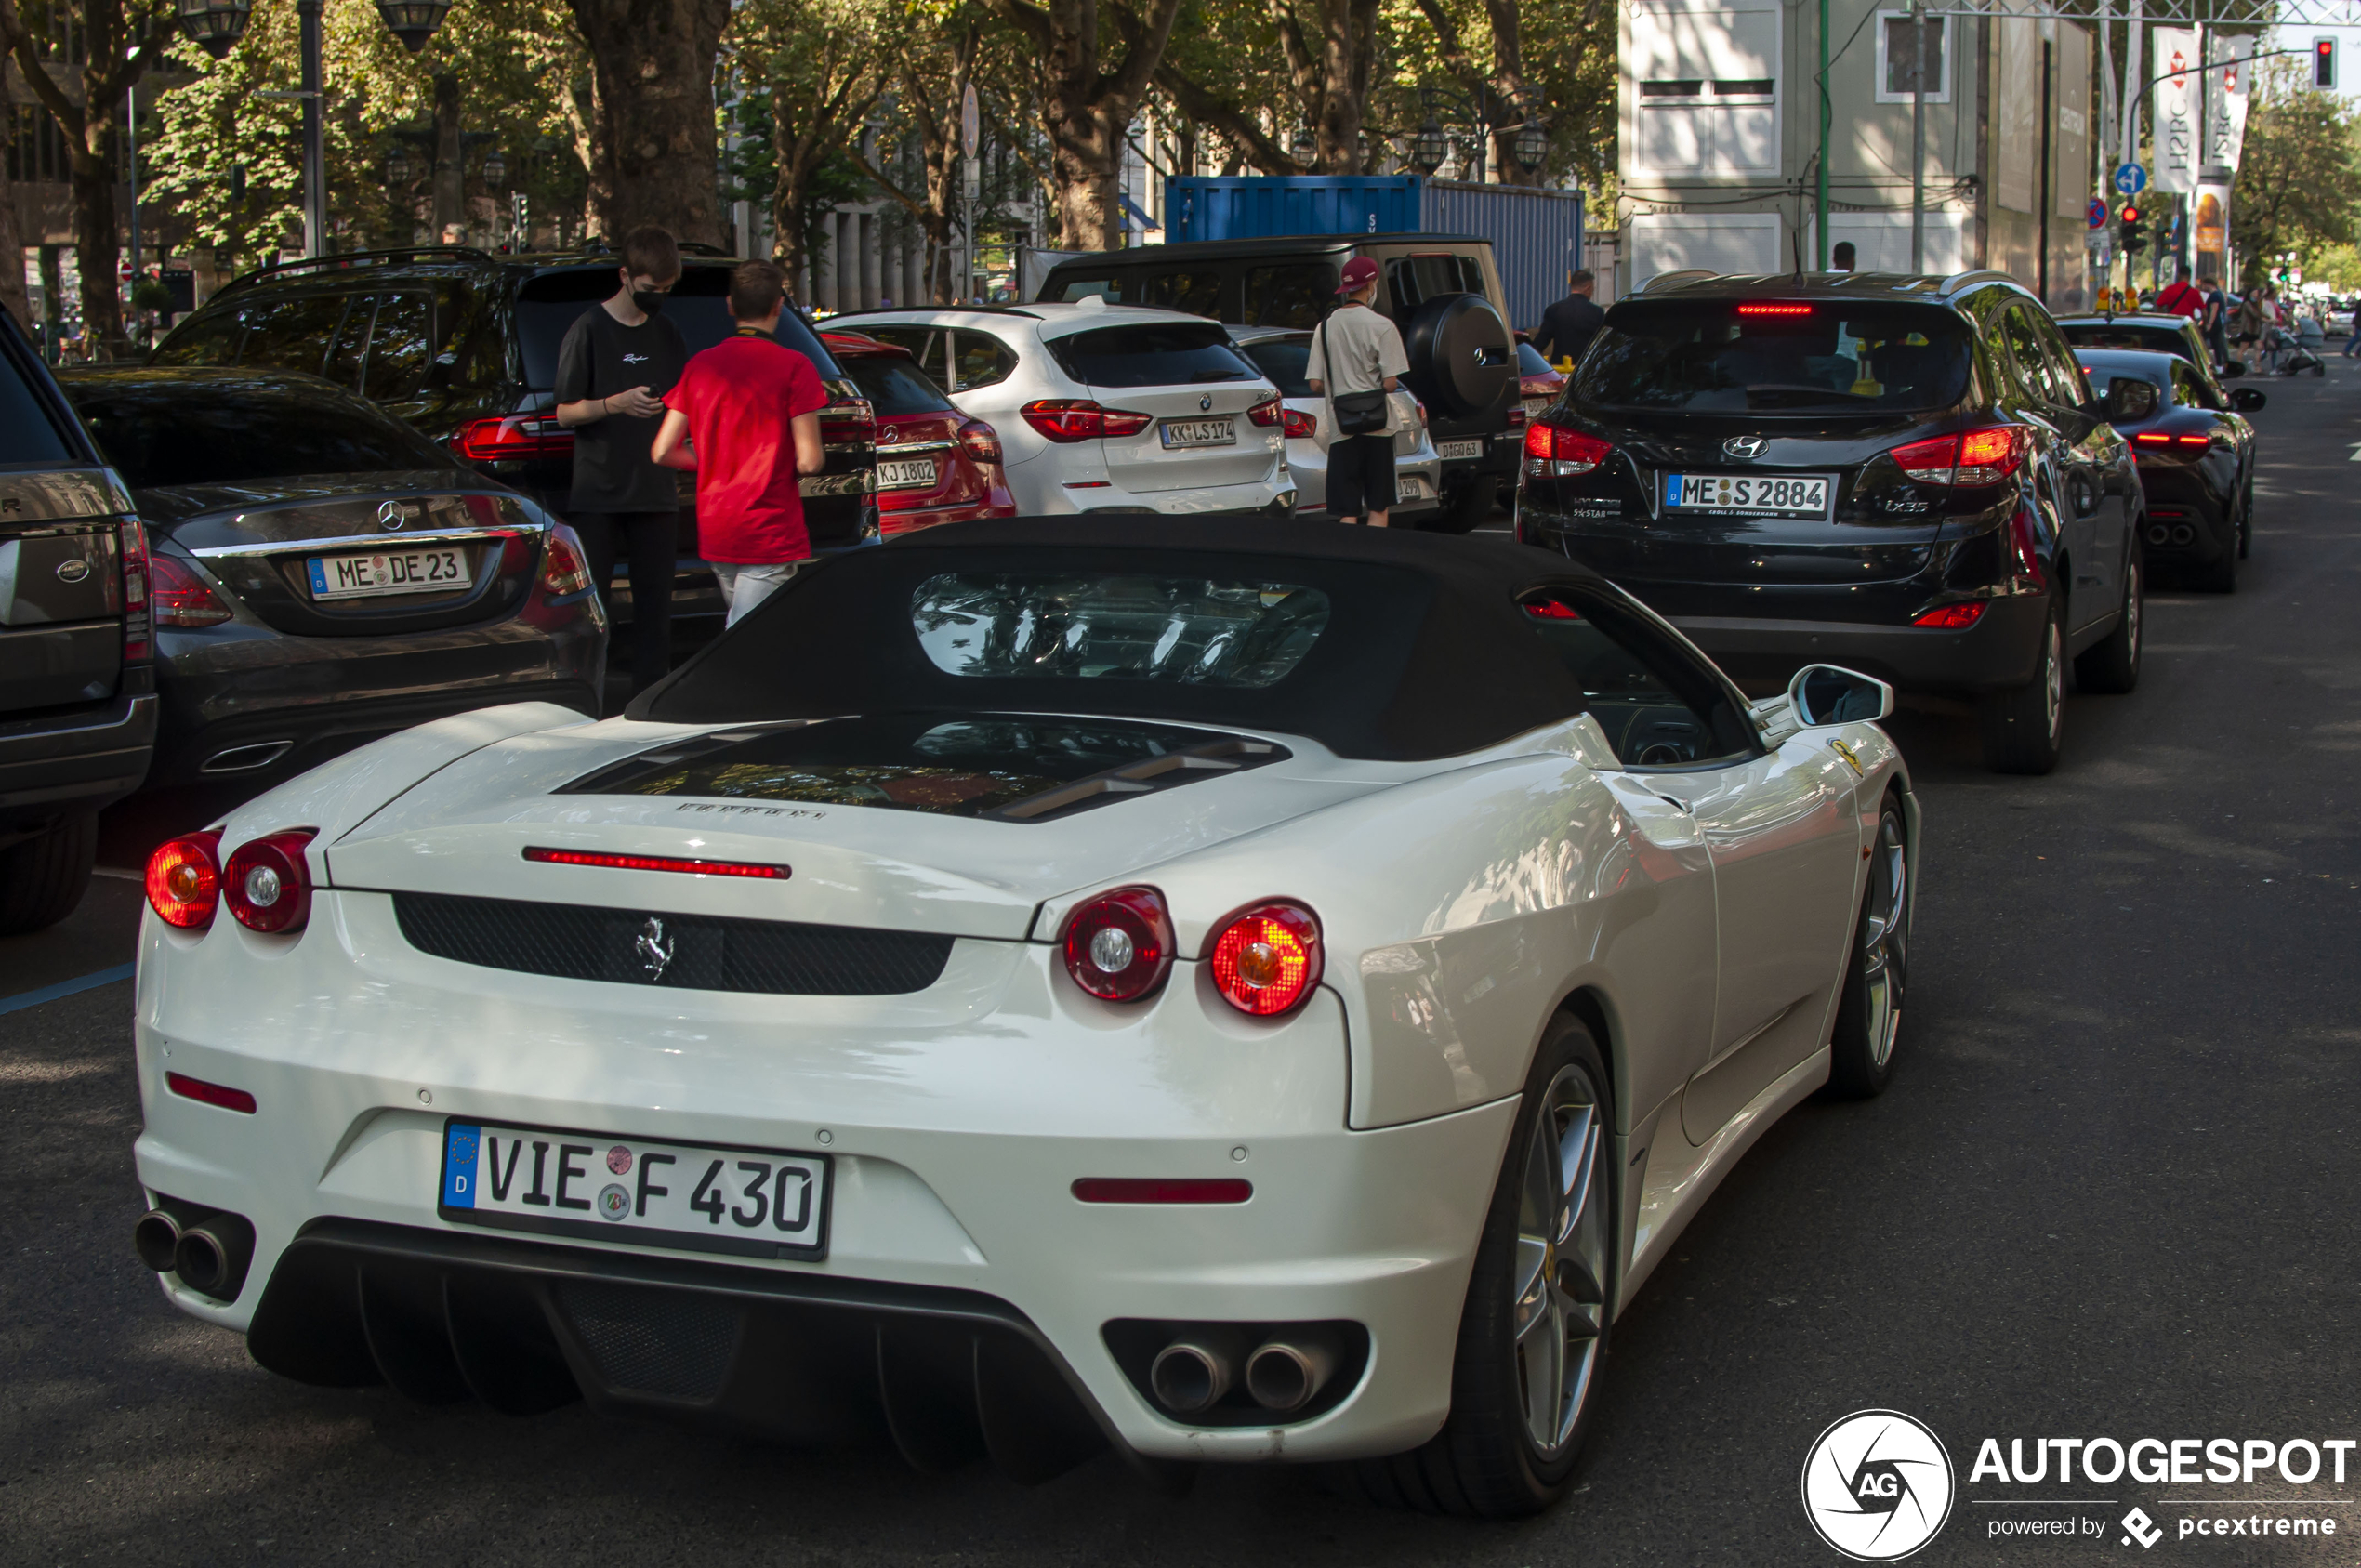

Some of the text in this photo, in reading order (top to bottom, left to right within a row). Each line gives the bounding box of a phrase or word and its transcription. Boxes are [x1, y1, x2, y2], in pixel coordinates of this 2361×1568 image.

[2170, 99, 2188, 169] HSBC
[1169, 422, 1233, 441] KK LS 174
[1443, 445, 1449, 458] D
[1466, 442, 1476, 455] 63
[878, 462, 934, 483] KJ 1802
[1682, 479, 1716, 504] ME
[1734, 480, 1750, 505] S
[1756, 481, 1822, 507] 2884
[336, 559, 374, 587] ME
[388, 555, 425, 583] DE
[426, 552, 458, 580] 23
[455, 1176, 467, 1193] D
[488, 1137, 593, 1210] VIE
[635, 1153, 676, 1216] F
[690, 1159, 812, 1232] 430
